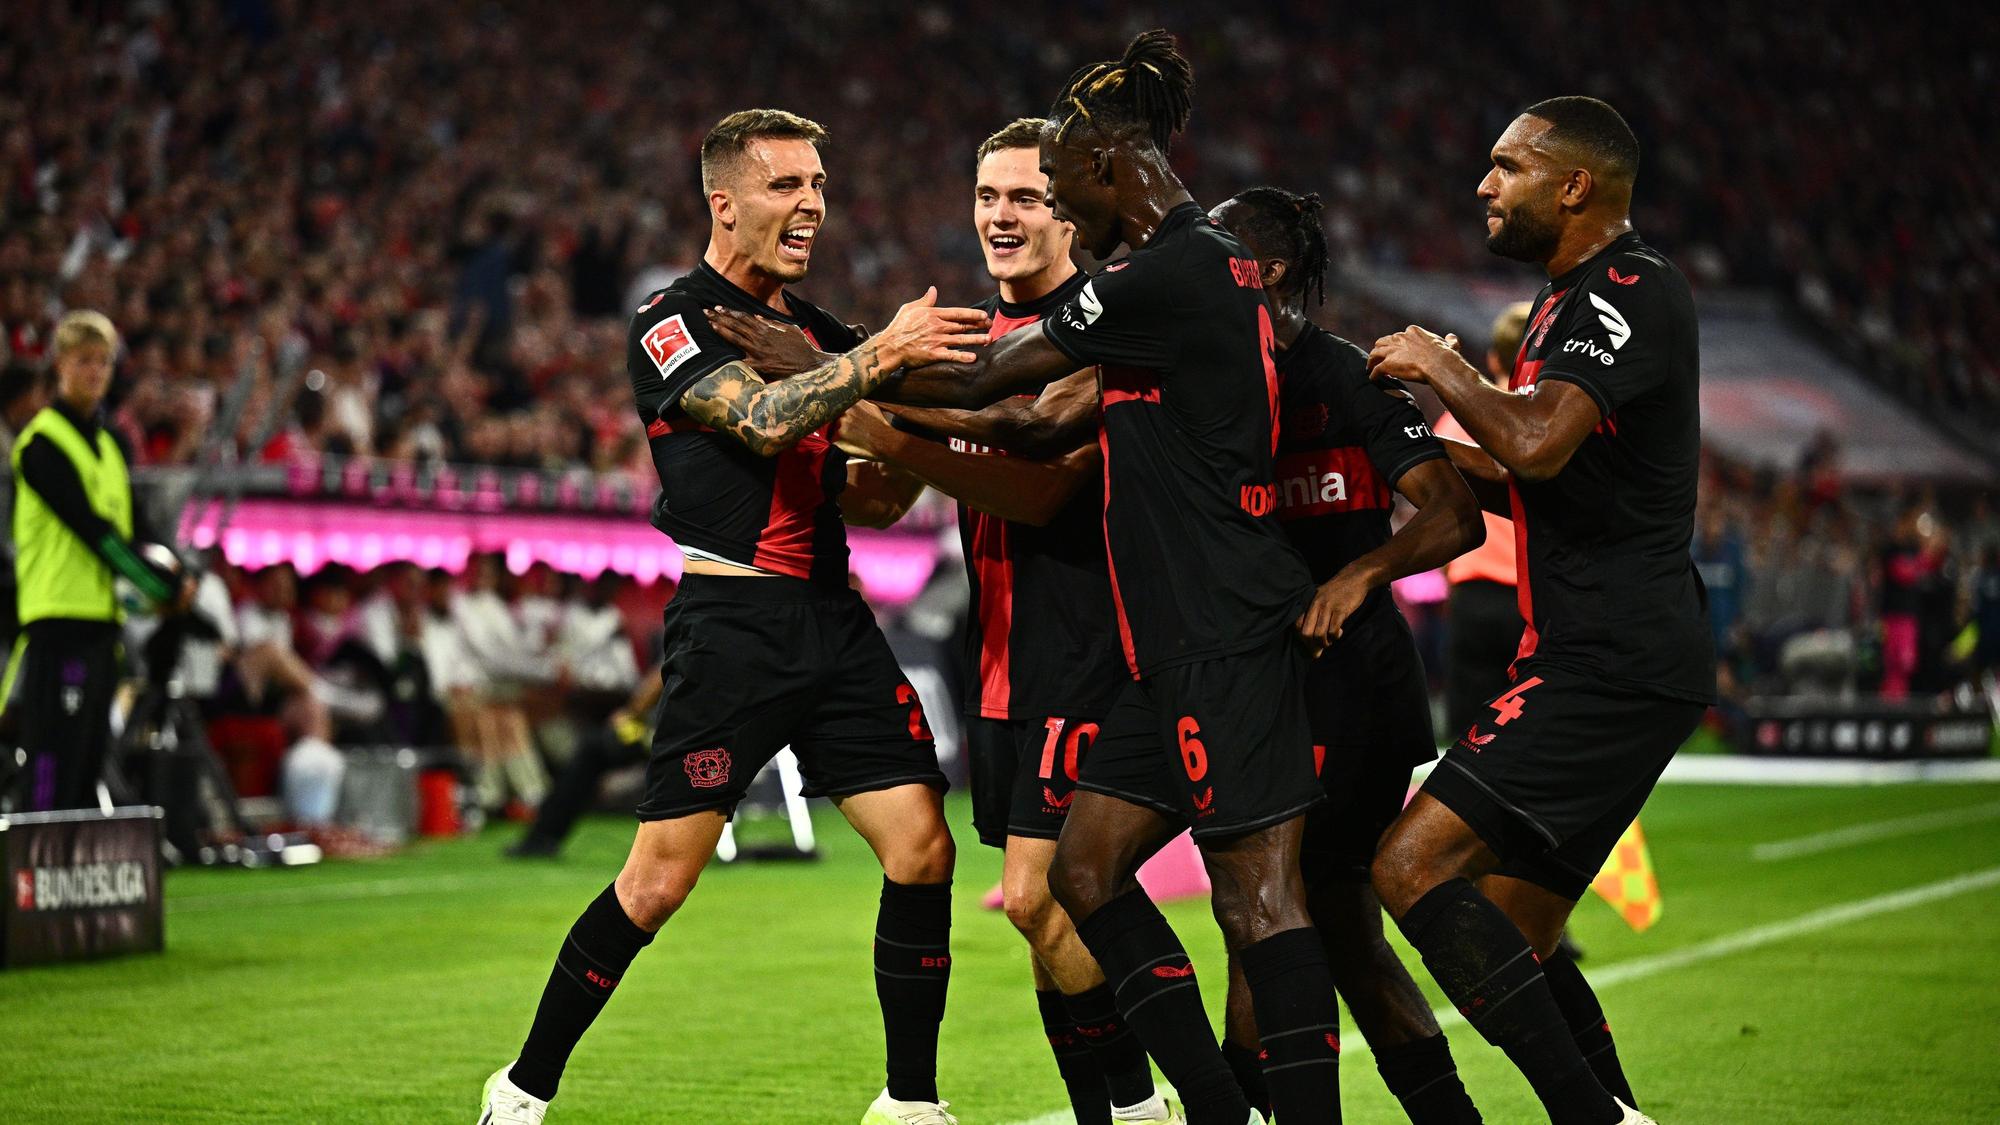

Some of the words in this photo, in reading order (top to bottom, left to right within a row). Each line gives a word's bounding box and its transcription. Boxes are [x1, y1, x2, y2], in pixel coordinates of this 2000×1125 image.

[663, 346, 695, 374] BUNDESLIGA
[1562, 338, 1616, 366] trive
[1488, 675, 1545, 727] 4
[1038, 716, 1101, 782] 10
[1176, 715, 1209, 782] 6
[35, 862, 147, 910] BUNDESLIGA
